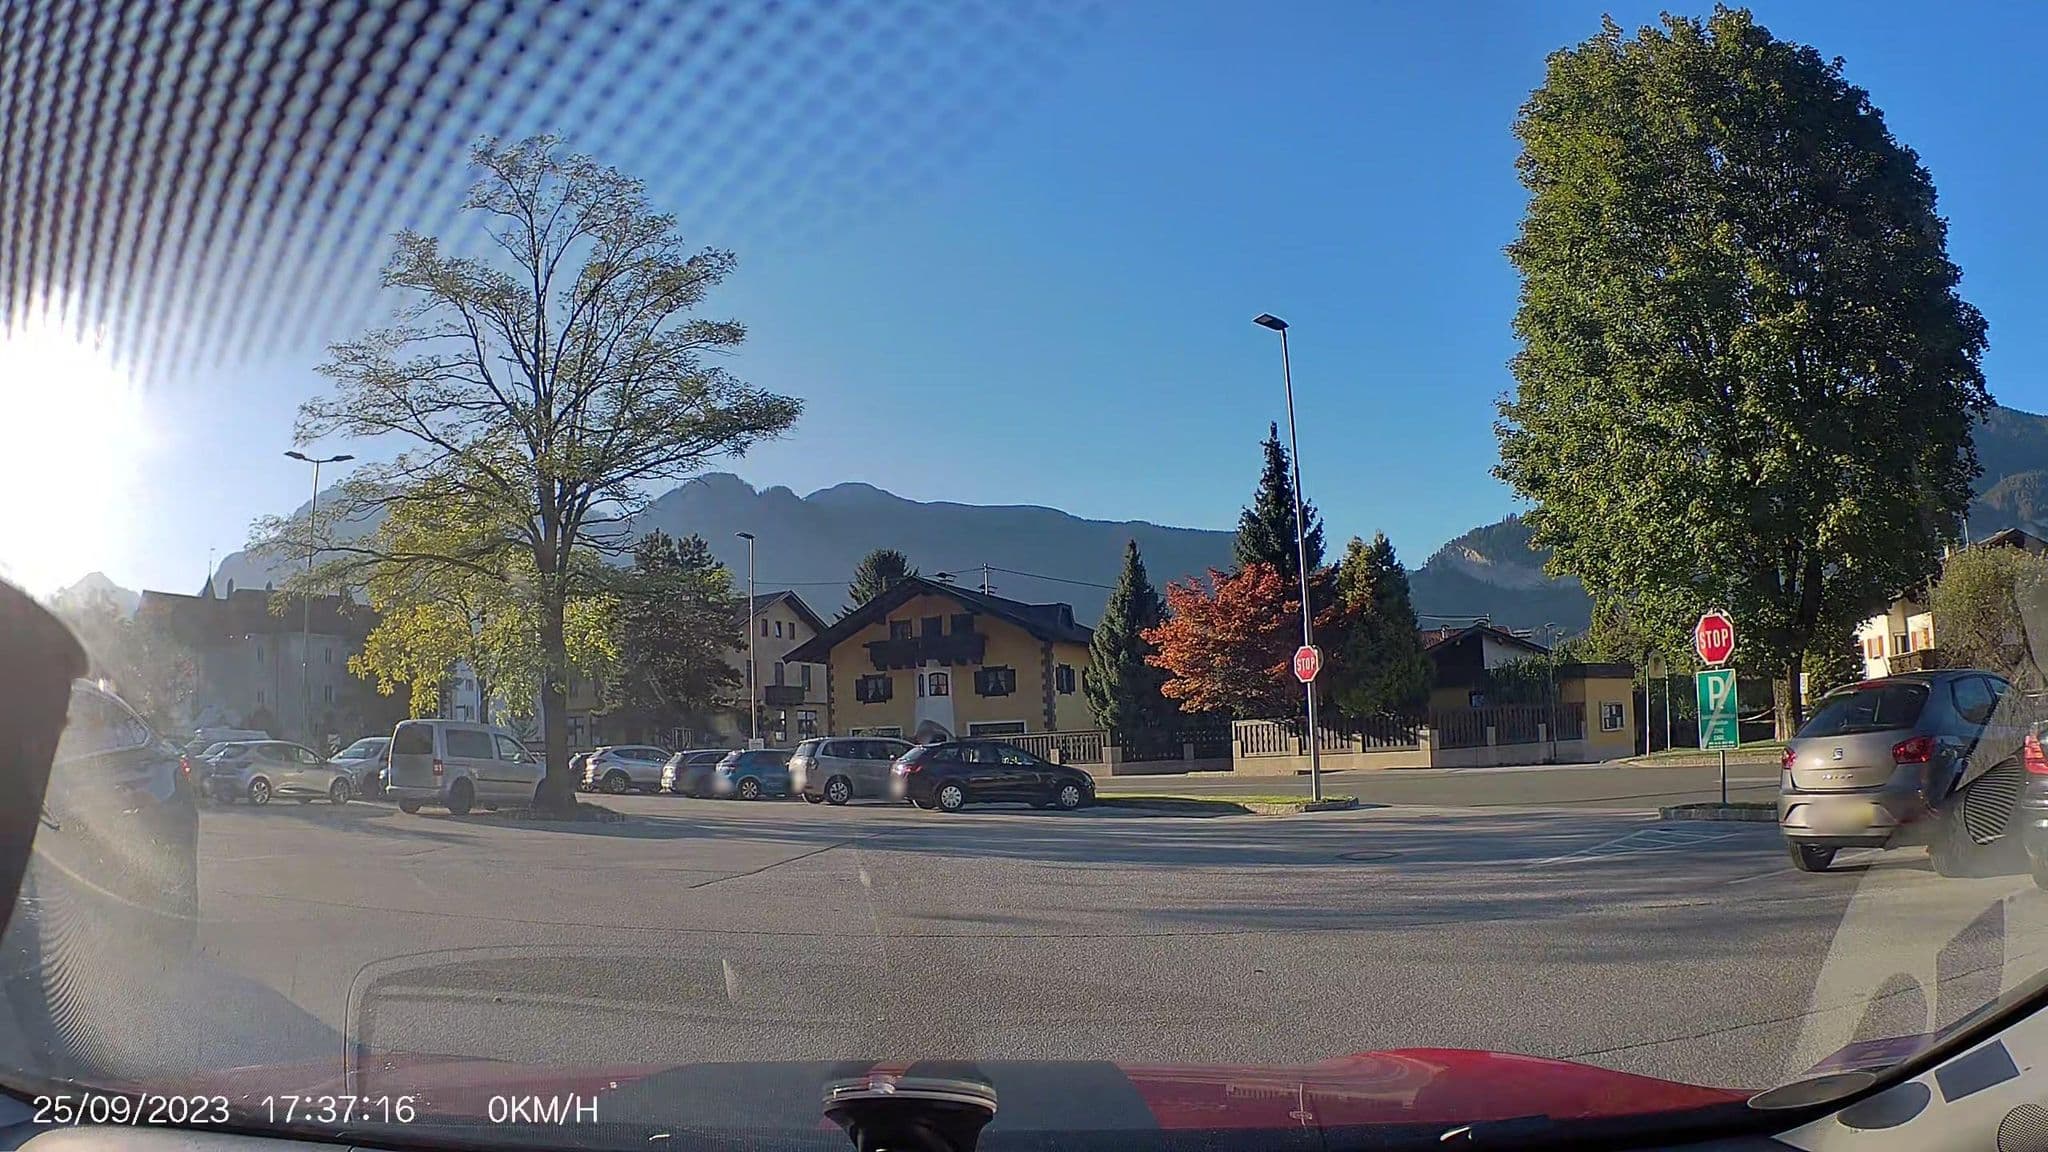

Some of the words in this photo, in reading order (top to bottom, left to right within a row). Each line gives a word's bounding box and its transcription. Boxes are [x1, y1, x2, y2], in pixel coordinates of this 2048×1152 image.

[1700, 628, 1728, 650] STOP
[1297, 656, 1315, 672] STOP
[1708, 676, 1725, 711] P
